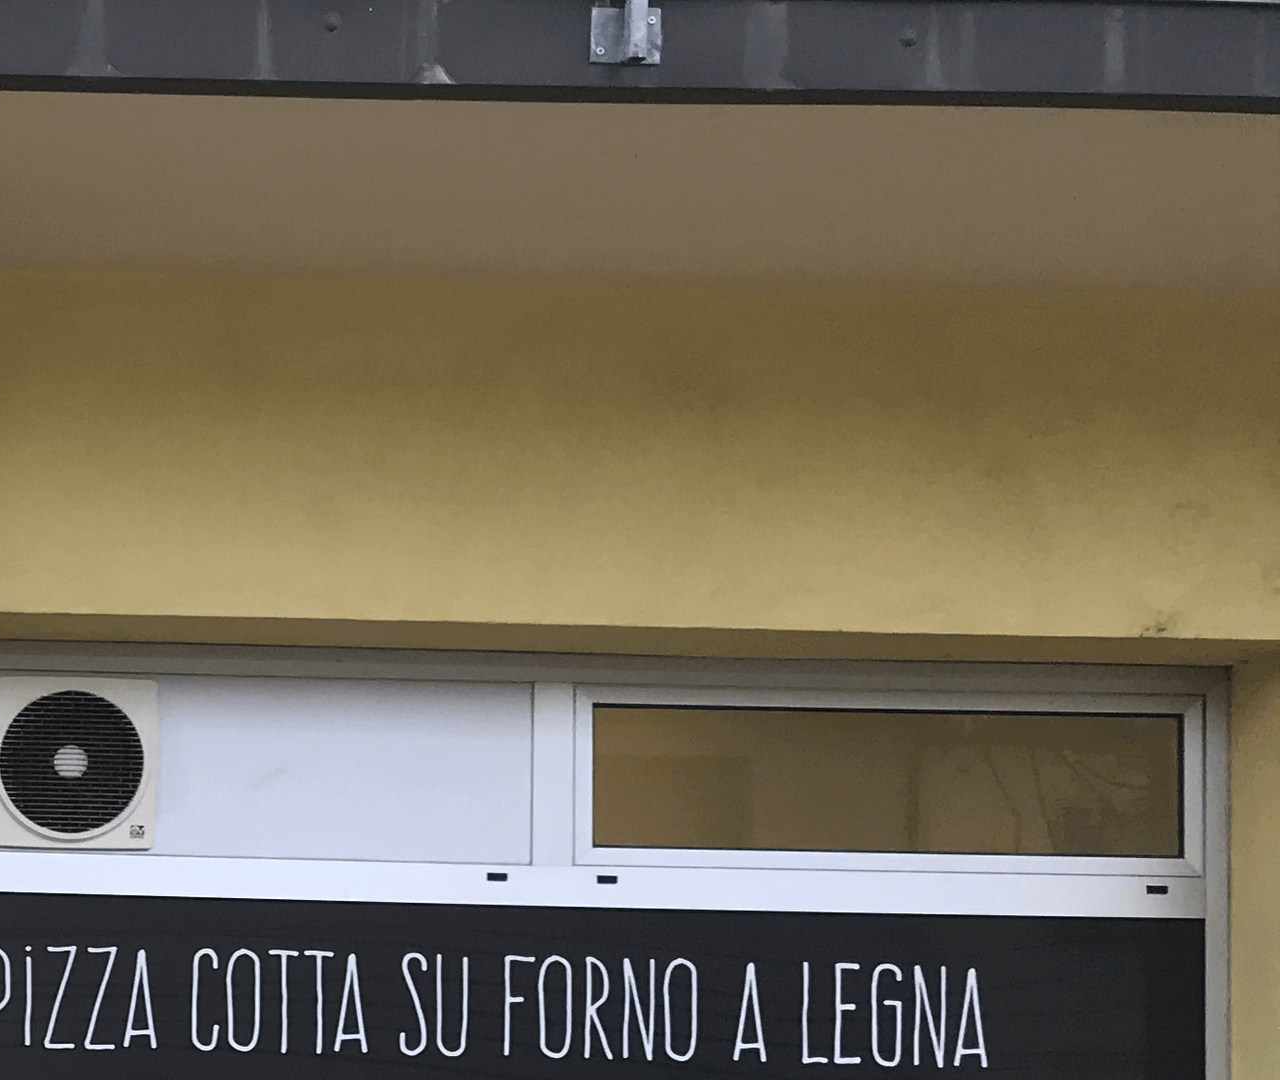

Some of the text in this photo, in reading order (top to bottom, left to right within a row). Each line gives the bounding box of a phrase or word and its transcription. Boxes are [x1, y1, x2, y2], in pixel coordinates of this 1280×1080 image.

[191, 947, 369, 1055] COTTA
[399, 952, 469, 1057] SU
[502, 954, 698, 1062] FORNO
[732, 962, 767, 1063] A
[801, 961, 988, 1069] LEGNA
